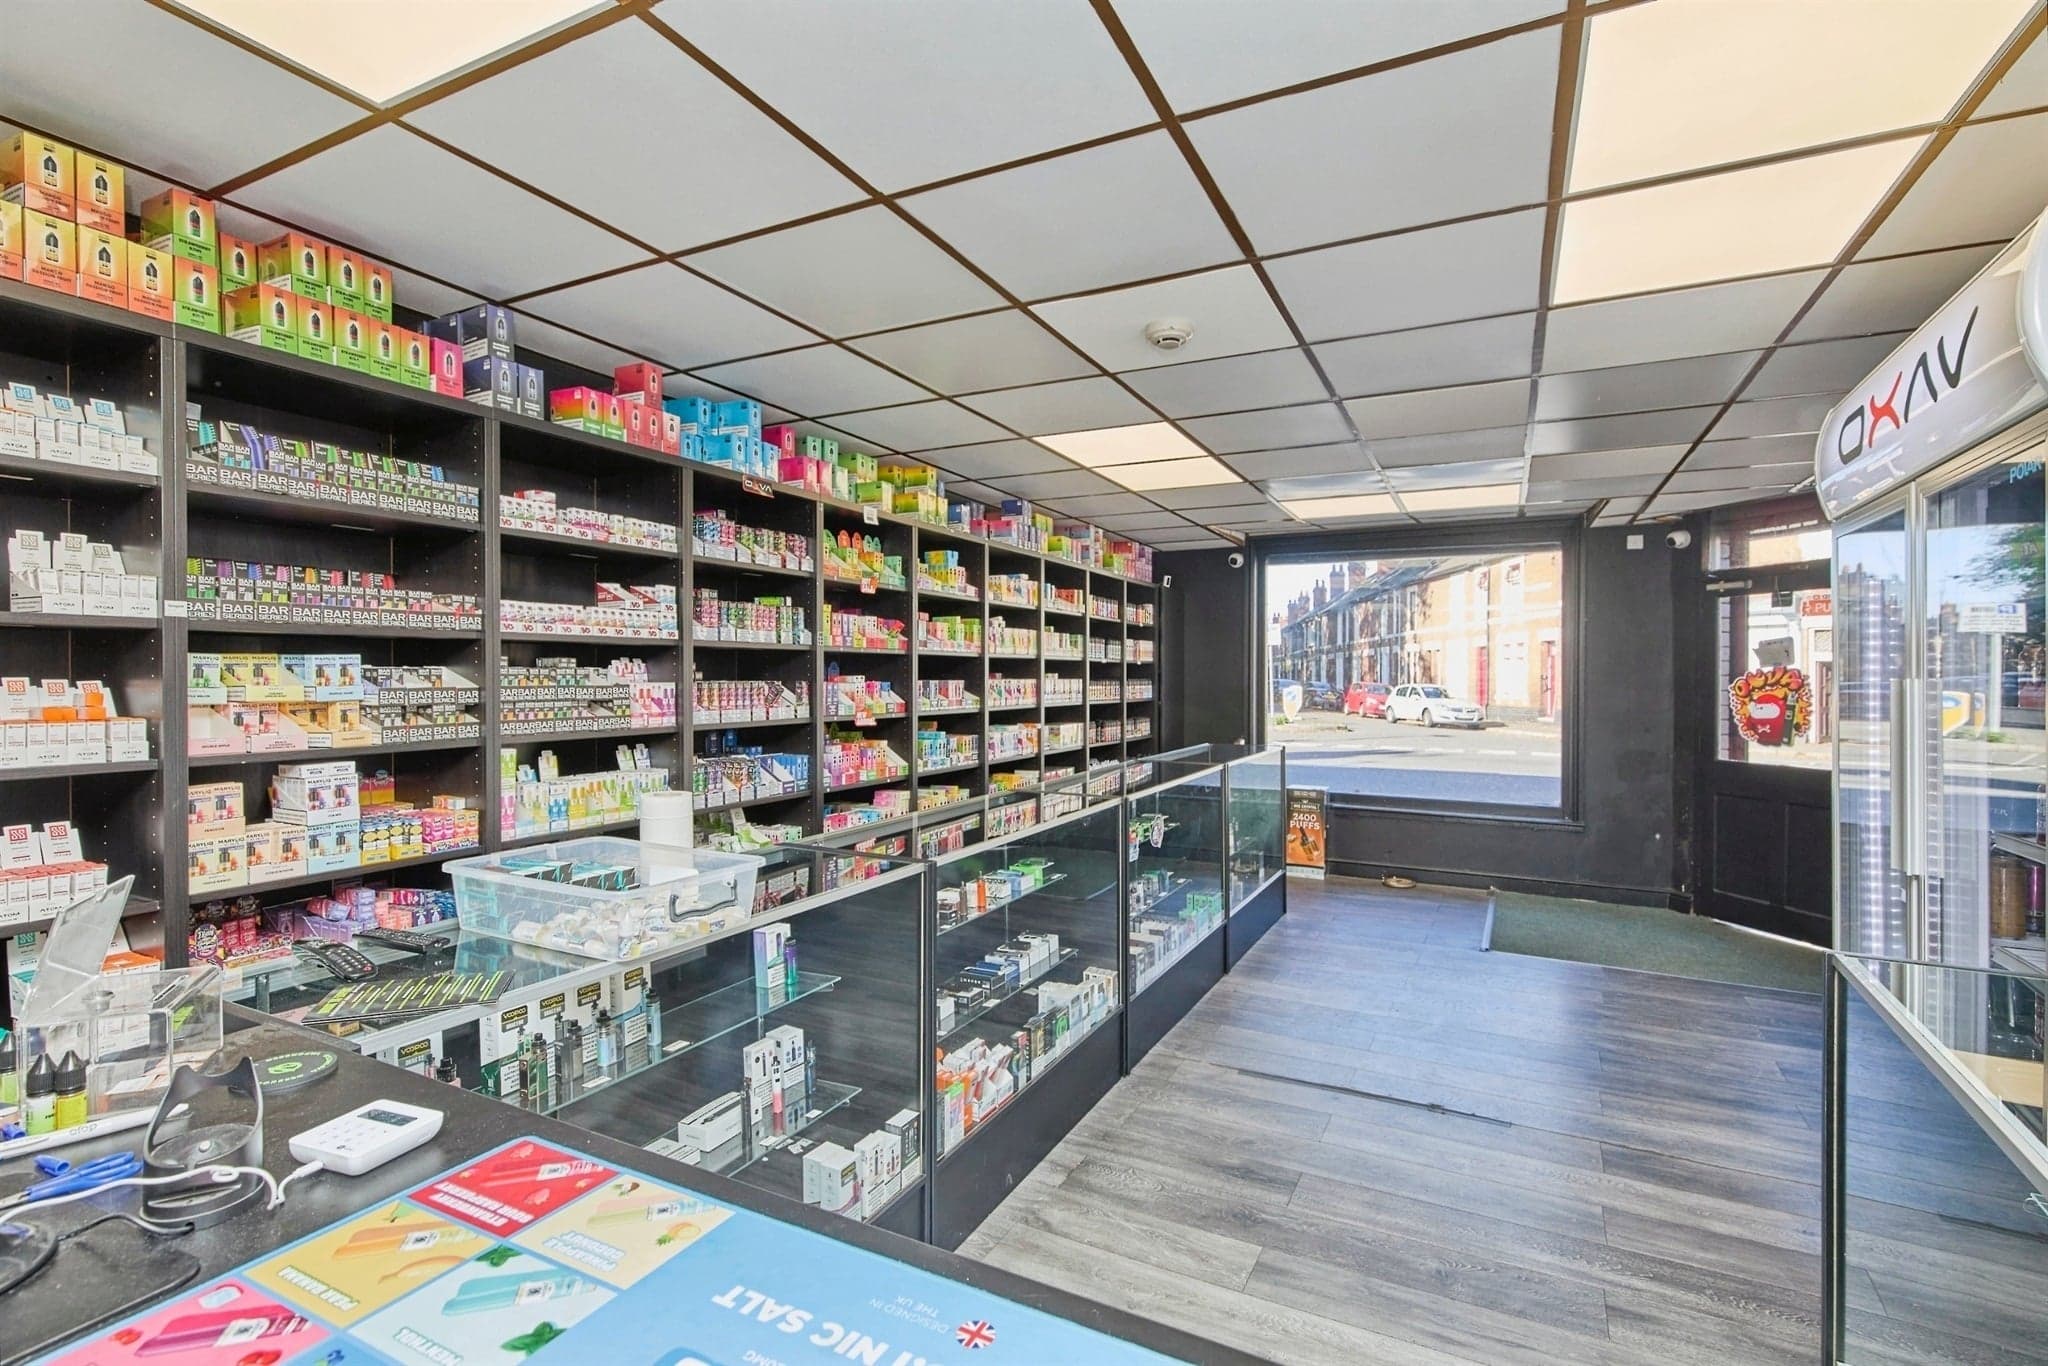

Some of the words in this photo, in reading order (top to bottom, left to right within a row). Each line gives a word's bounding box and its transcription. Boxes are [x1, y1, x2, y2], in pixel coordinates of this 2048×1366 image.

[186, 463, 217, 476] BAR
[220, 469, 252, 481] BAR
[258, 474, 287, 486] BAR
[288, 480, 315, 491] BAR
[320, 485, 347, 497] BAR
[352, 490, 377, 500] BAR
[380, 495, 403, 504] BAR
[408, 498, 431, 509] BAR
[434, 502, 455, 512] BAR
[457, 506, 479, 515] BAR
[223, 604, 253, 613] BAR
[259, 606, 288, 614] BAR
[293, 608, 320, 617] BAR
[324, 609, 351, 618] BAR
[353, 611, 378, 620] BAR
[382, 612, 406, 621] BAR
[409, 614, 432, 622] BAR
[434, 615, 455, 623] BAR
[460, 616, 481, 625] BAR
[380, 690, 404, 699] BAR
[409, 690, 432, 700] BAR
[434, 690, 456, 698] BAR
[458, 690, 478, 698] BAR
[537, 688, 555, 696] BAR
[558, 688, 576, 696] BAR
[576, 688, 594, 696] BAR
[517, 722, 535, 730] BAR
[556, 720, 574, 728] BAR
[575, 720, 593, 728] BAR
[599, 718, 615, 726] BAR
[615, 718, 631, 726] BAR
[383, 729, 406, 738] BAR
[410, 728, 432, 736] BAR
[434, 726, 456, 735] BAR
[458, 725, 479, 734] BAR
[1292, 813, 1317, 822] 2400
[1290, 820, 1320, 830] PUFFS
[400, 1041, 430, 1054] VOOPOO
[562, 1231, 626, 1260] COCONUT
[544, 1237, 616, 1272] PINEAPPLE
[870, 1298, 884, 1309] IN
[895, 1295, 914, 1307] UK
[711, 1285, 814, 1334] SALT
[917, 1303, 940, 1318] THE
[885, 1305, 950, 1334] DESIGNED
[809, 1322, 889, 1366] NIC
